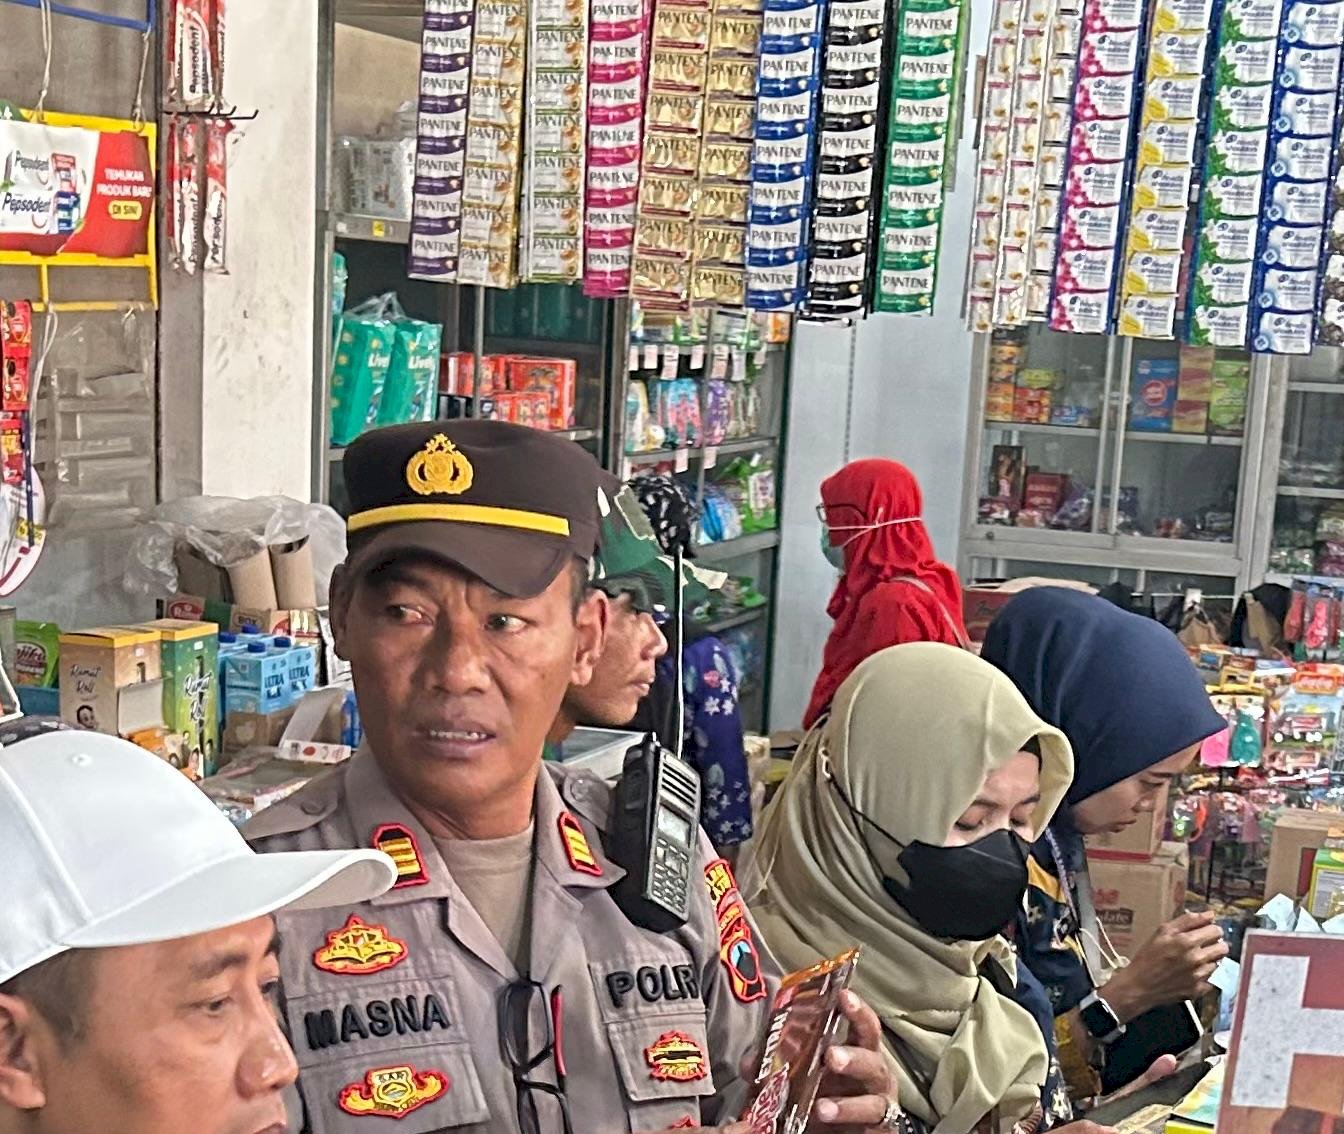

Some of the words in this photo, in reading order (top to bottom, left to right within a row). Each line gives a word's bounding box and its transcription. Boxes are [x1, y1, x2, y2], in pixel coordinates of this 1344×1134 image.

[264, 675, 286, 689] ULTRA
[603, 962, 699, 1009] POLR
[305, 993, 451, 1050] MASNA
